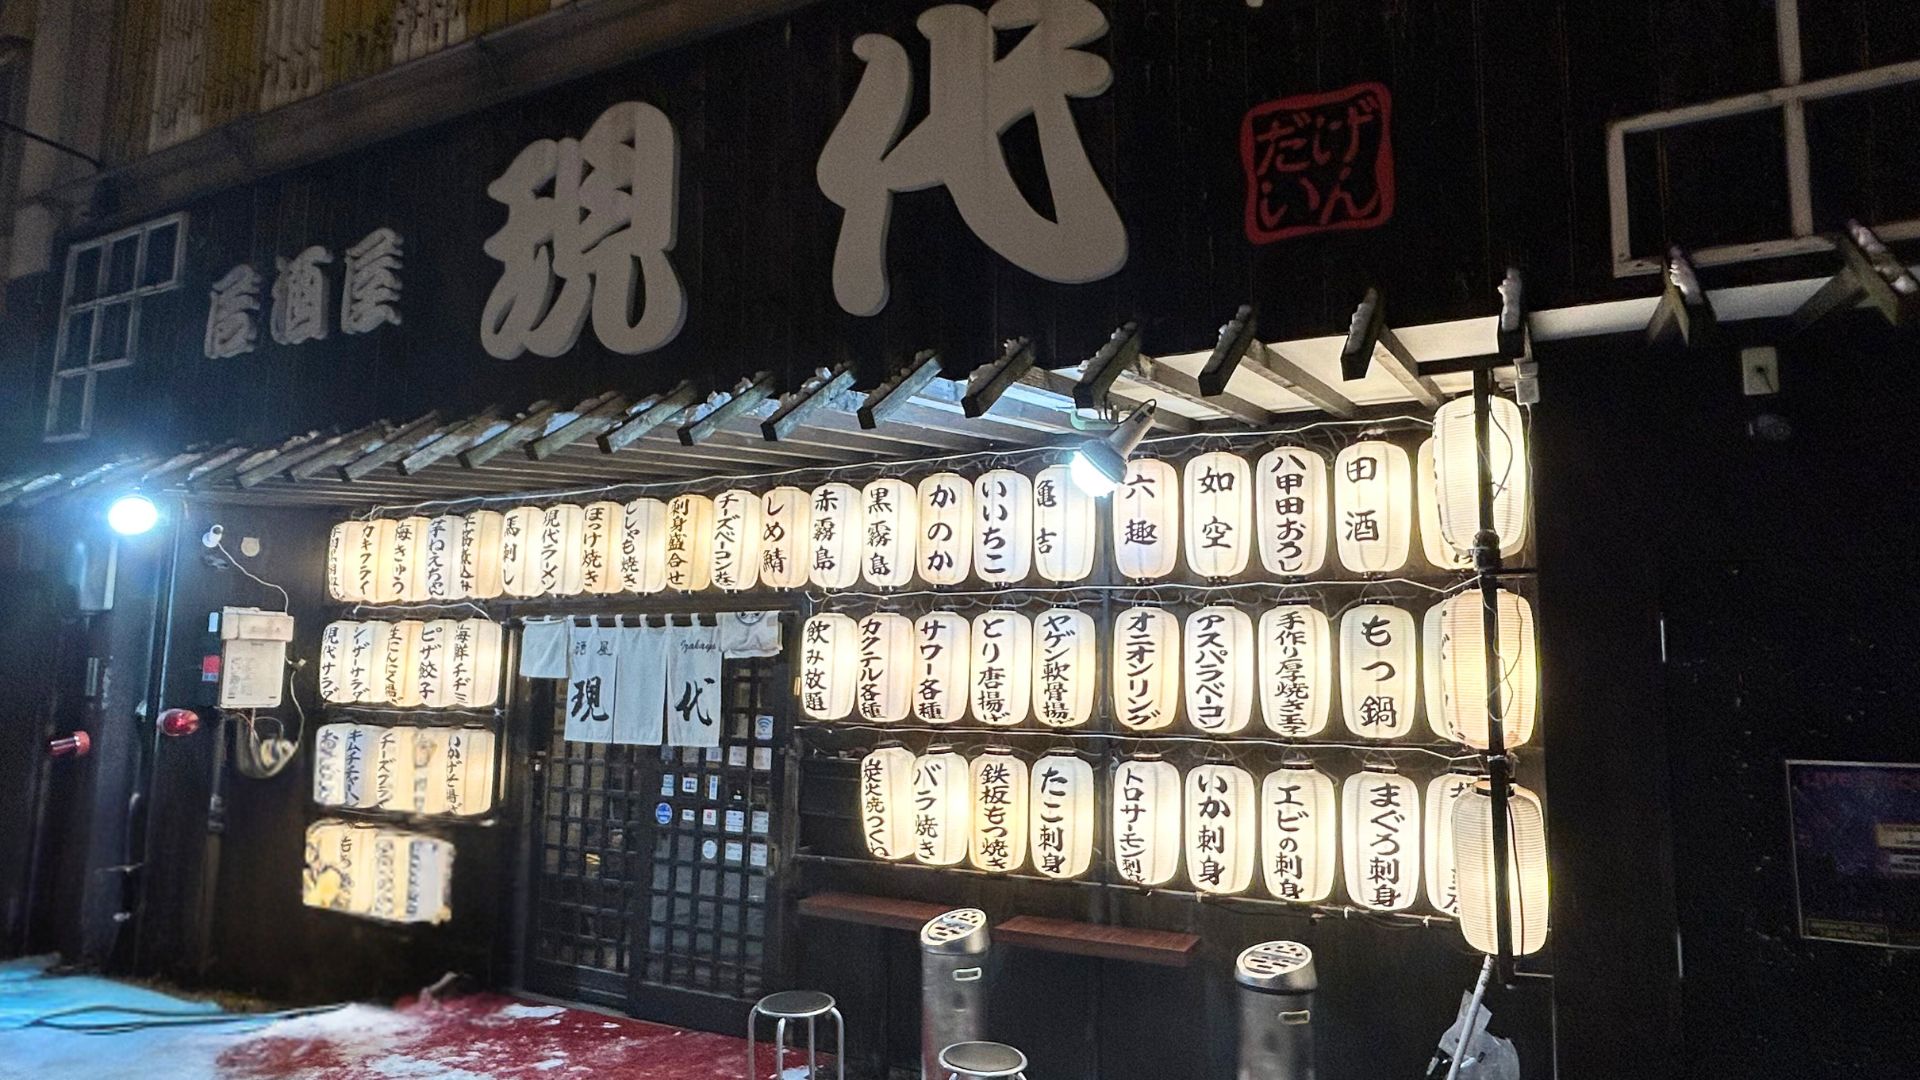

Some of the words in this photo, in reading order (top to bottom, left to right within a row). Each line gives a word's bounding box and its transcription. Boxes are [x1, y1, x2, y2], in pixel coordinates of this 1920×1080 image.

[481, 0, 1128, 361] 現代
[203, 227, 404, 360] 居酒屋
[667, 498, 690, 586] 刺身盛合せ
[762, 497, 787, 574] しめ鯖
[812, 489, 839, 571] 赤霧島
[867, 487, 893, 576] 黒霧島
[928, 484, 955, 572] かのか
[982, 480, 1008, 574] いいちこ
[1125, 474, 1158, 545] 六趣
[1197, 466, 1235, 549] 如空
[1271, 454, 1306, 572] 八甲田おろし
[1345, 456, 1379, 542] 田酒
[359, 525, 375, 595] カキフライ
[503, 515, 521, 586] 馬刺し
[541, 510, 561, 590] 現代ラーメン
[581, 507, 605, 588] ほっけ焼き
[620, 502, 641, 588] ししゃも焼き
[321, 626, 340, 700] 現代サラダ
[350, 626, 370, 701] シーザーサラダ
[419, 626, 442, 700] ピザ餃子
[453, 625, 471, 704] 海鮮チヂミ
[570, 676, 716, 726] 現代
[804, 620, 831, 711] 飲み放題
[859, 618, 886, 719] カクテル各種
[918, 619, 946, 720] サワー各種
[977, 618, 1011, 722] とり唐揚げ
[1040, 615, 1076, 724] ヤゲン軟骨揚げ
[1126, 611, 1160, 726] オニオンリング
[1195, 614, 1228, 729] アスパラベーコン
[1273, 611, 1309, 734] 手作り厚焼き玉子
[1359, 614, 1397, 728] もつ鍋
[377, 732, 396, 807] チーズフライ
[864, 758, 891, 857] 炭火焼つくね
[913, 764, 942, 859] バラ焼き
[979, 763, 1012, 869] 鉄板もつ焼き
[1037, 766, 1068, 874] たこ刺身
[1197, 774, 1230, 885] いか刺身
[1273, 785, 1309, 899] エビの刺身
[1369, 782, 1406, 907] まぐろ刺身
